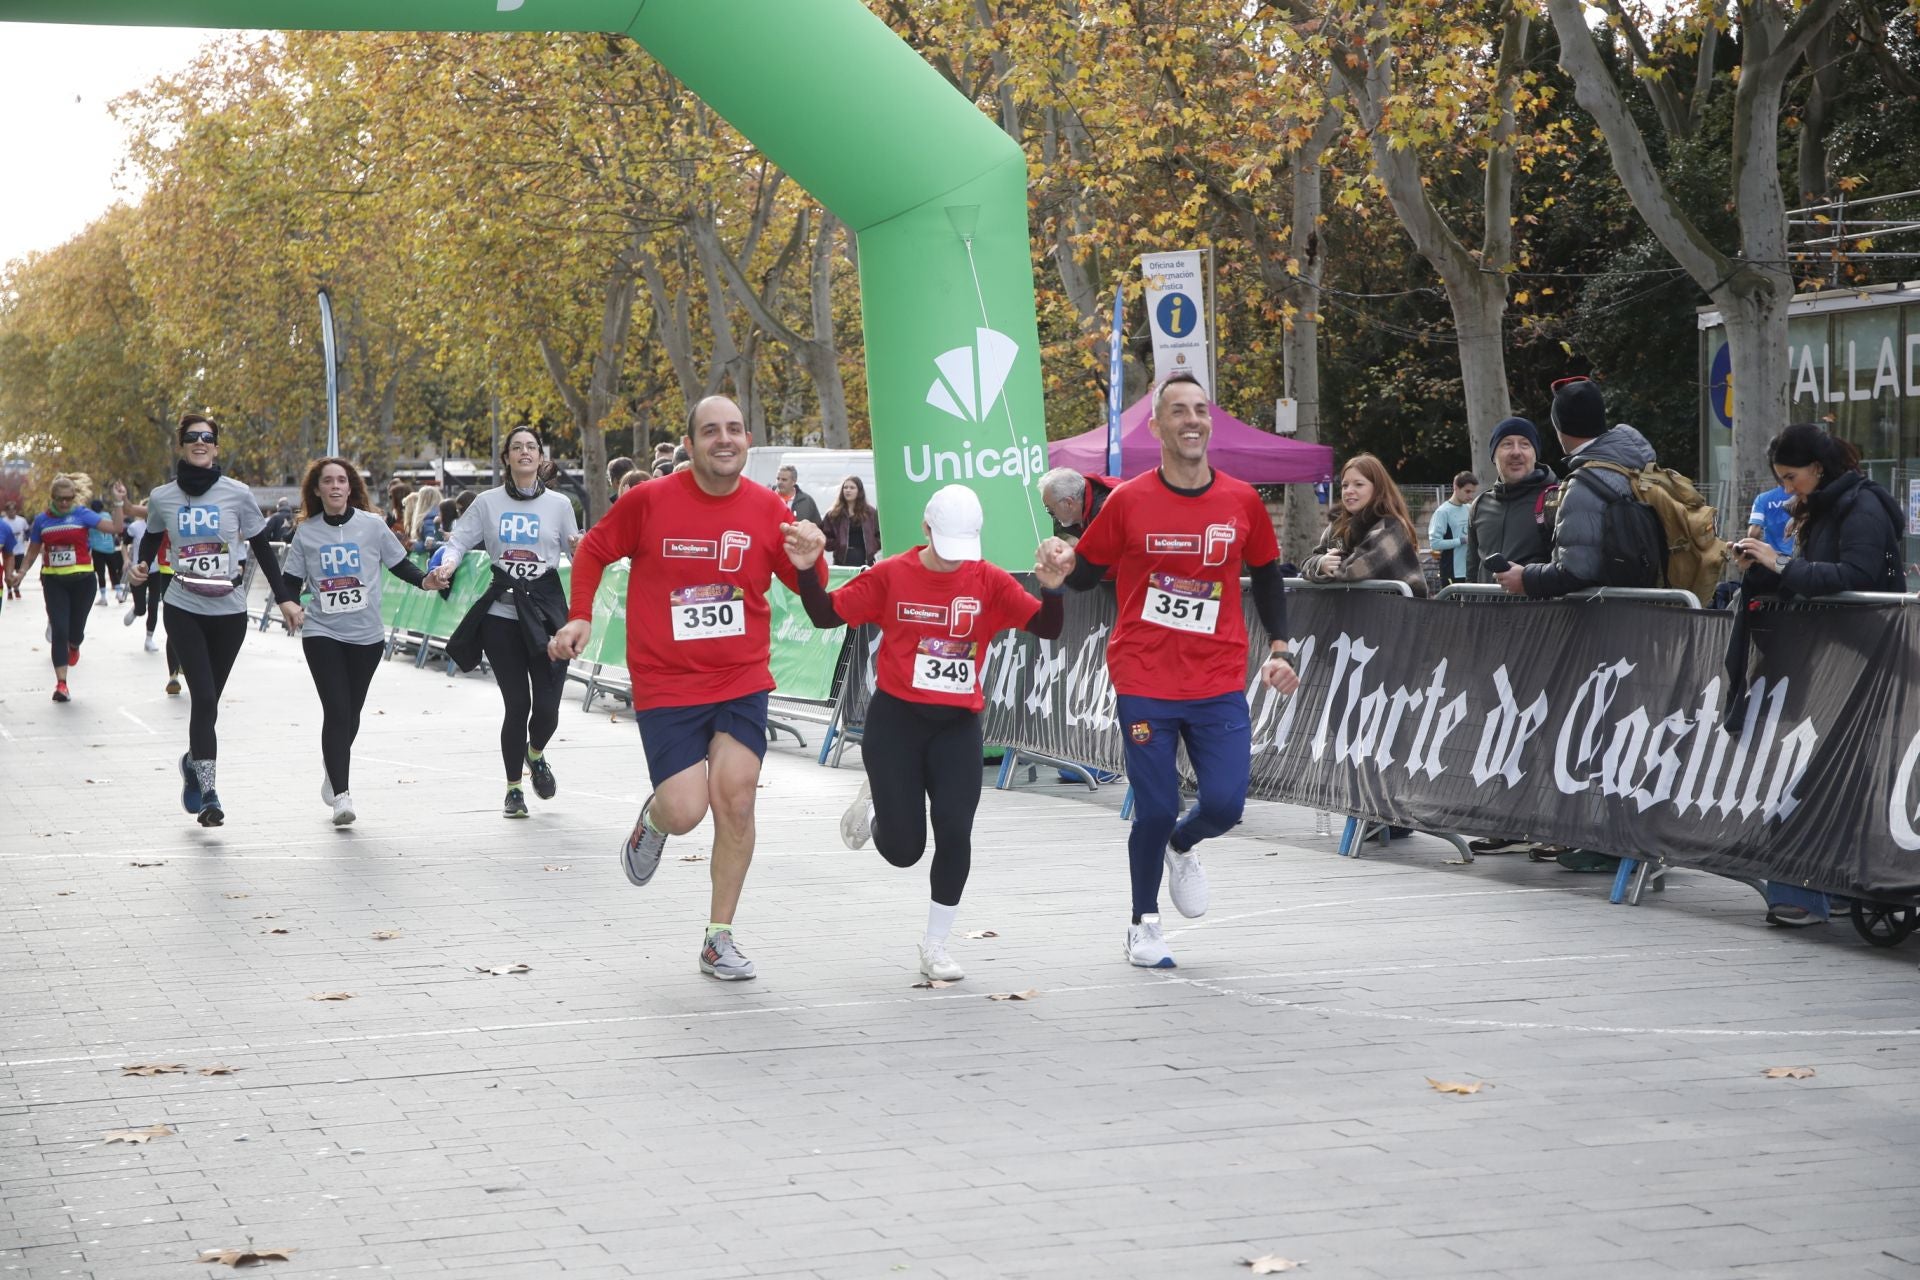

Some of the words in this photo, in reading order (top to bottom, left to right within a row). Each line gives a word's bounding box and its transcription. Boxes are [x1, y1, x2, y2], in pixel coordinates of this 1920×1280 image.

[1149, 261, 1175, 270] Oficina
[1175, 259, 1185, 268] de
[1788, 333, 1920, 404] ALLA
[903, 436, 1044, 486] Unicaja
[178, 507, 219, 534] PPG
[500, 514, 539, 541] PPG
[51, 552, 71, 561] 752
[186, 556, 220, 571] 761
[320, 546, 359, 574] PPG
[505, 562, 538, 577] 762
[326, 589, 362, 607] 763
[1154, 593, 1205, 622] 351
[683, 604, 734, 629] 350
[925, 659, 969, 683] 349
[1311, 631, 1468, 782] Norte
[1469, 663, 1548, 790] de
[1553, 657, 1819, 826] Castilla
